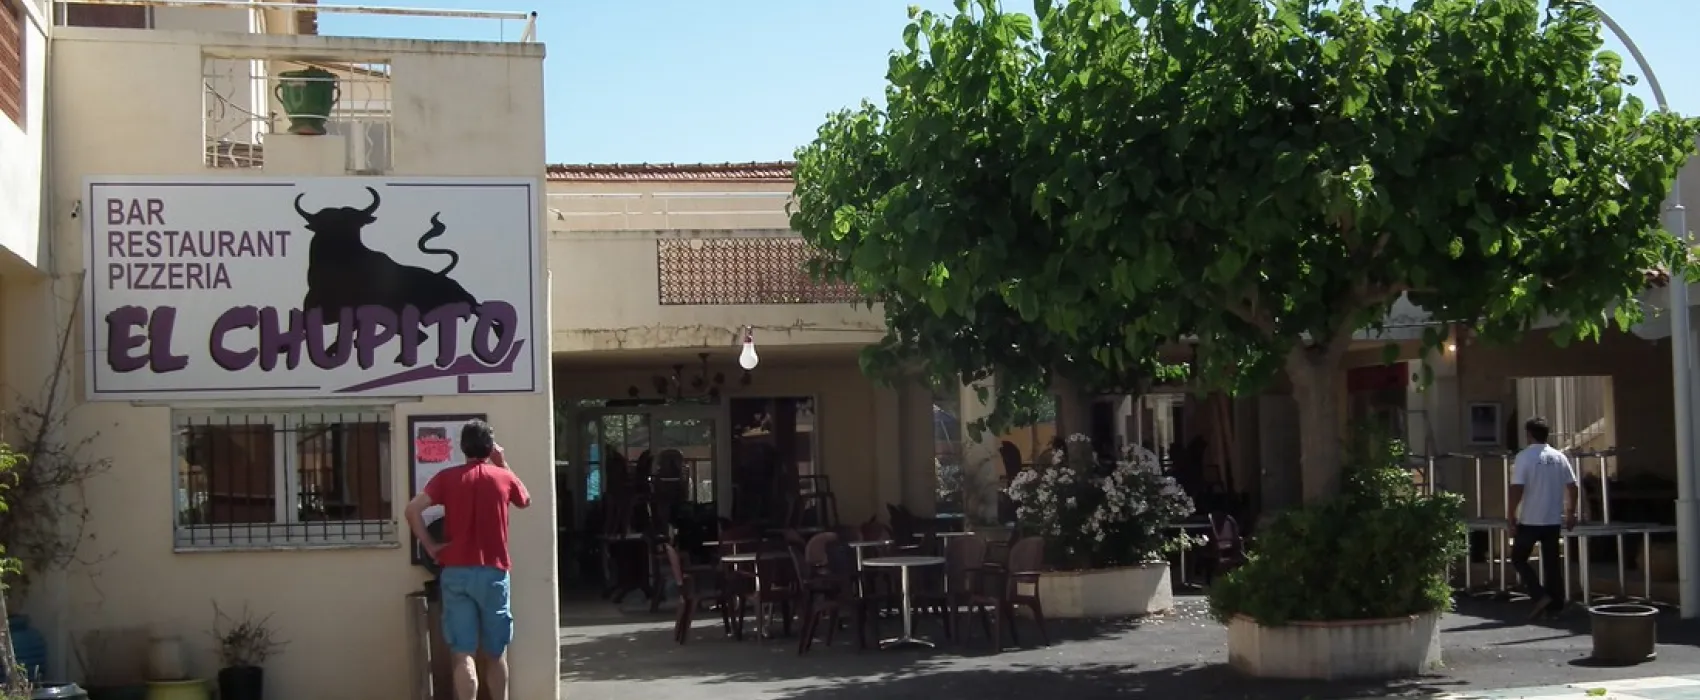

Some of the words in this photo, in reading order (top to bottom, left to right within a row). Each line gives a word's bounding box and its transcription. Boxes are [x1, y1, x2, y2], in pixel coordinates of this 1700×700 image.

[107, 199, 165, 225] BAR
[107, 231, 291, 258] RESTAURANT
[109, 263, 232, 290] PIZZERIA
[106, 305, 189, 373] EL
[209, 301, 518, 373] CHUPITO
